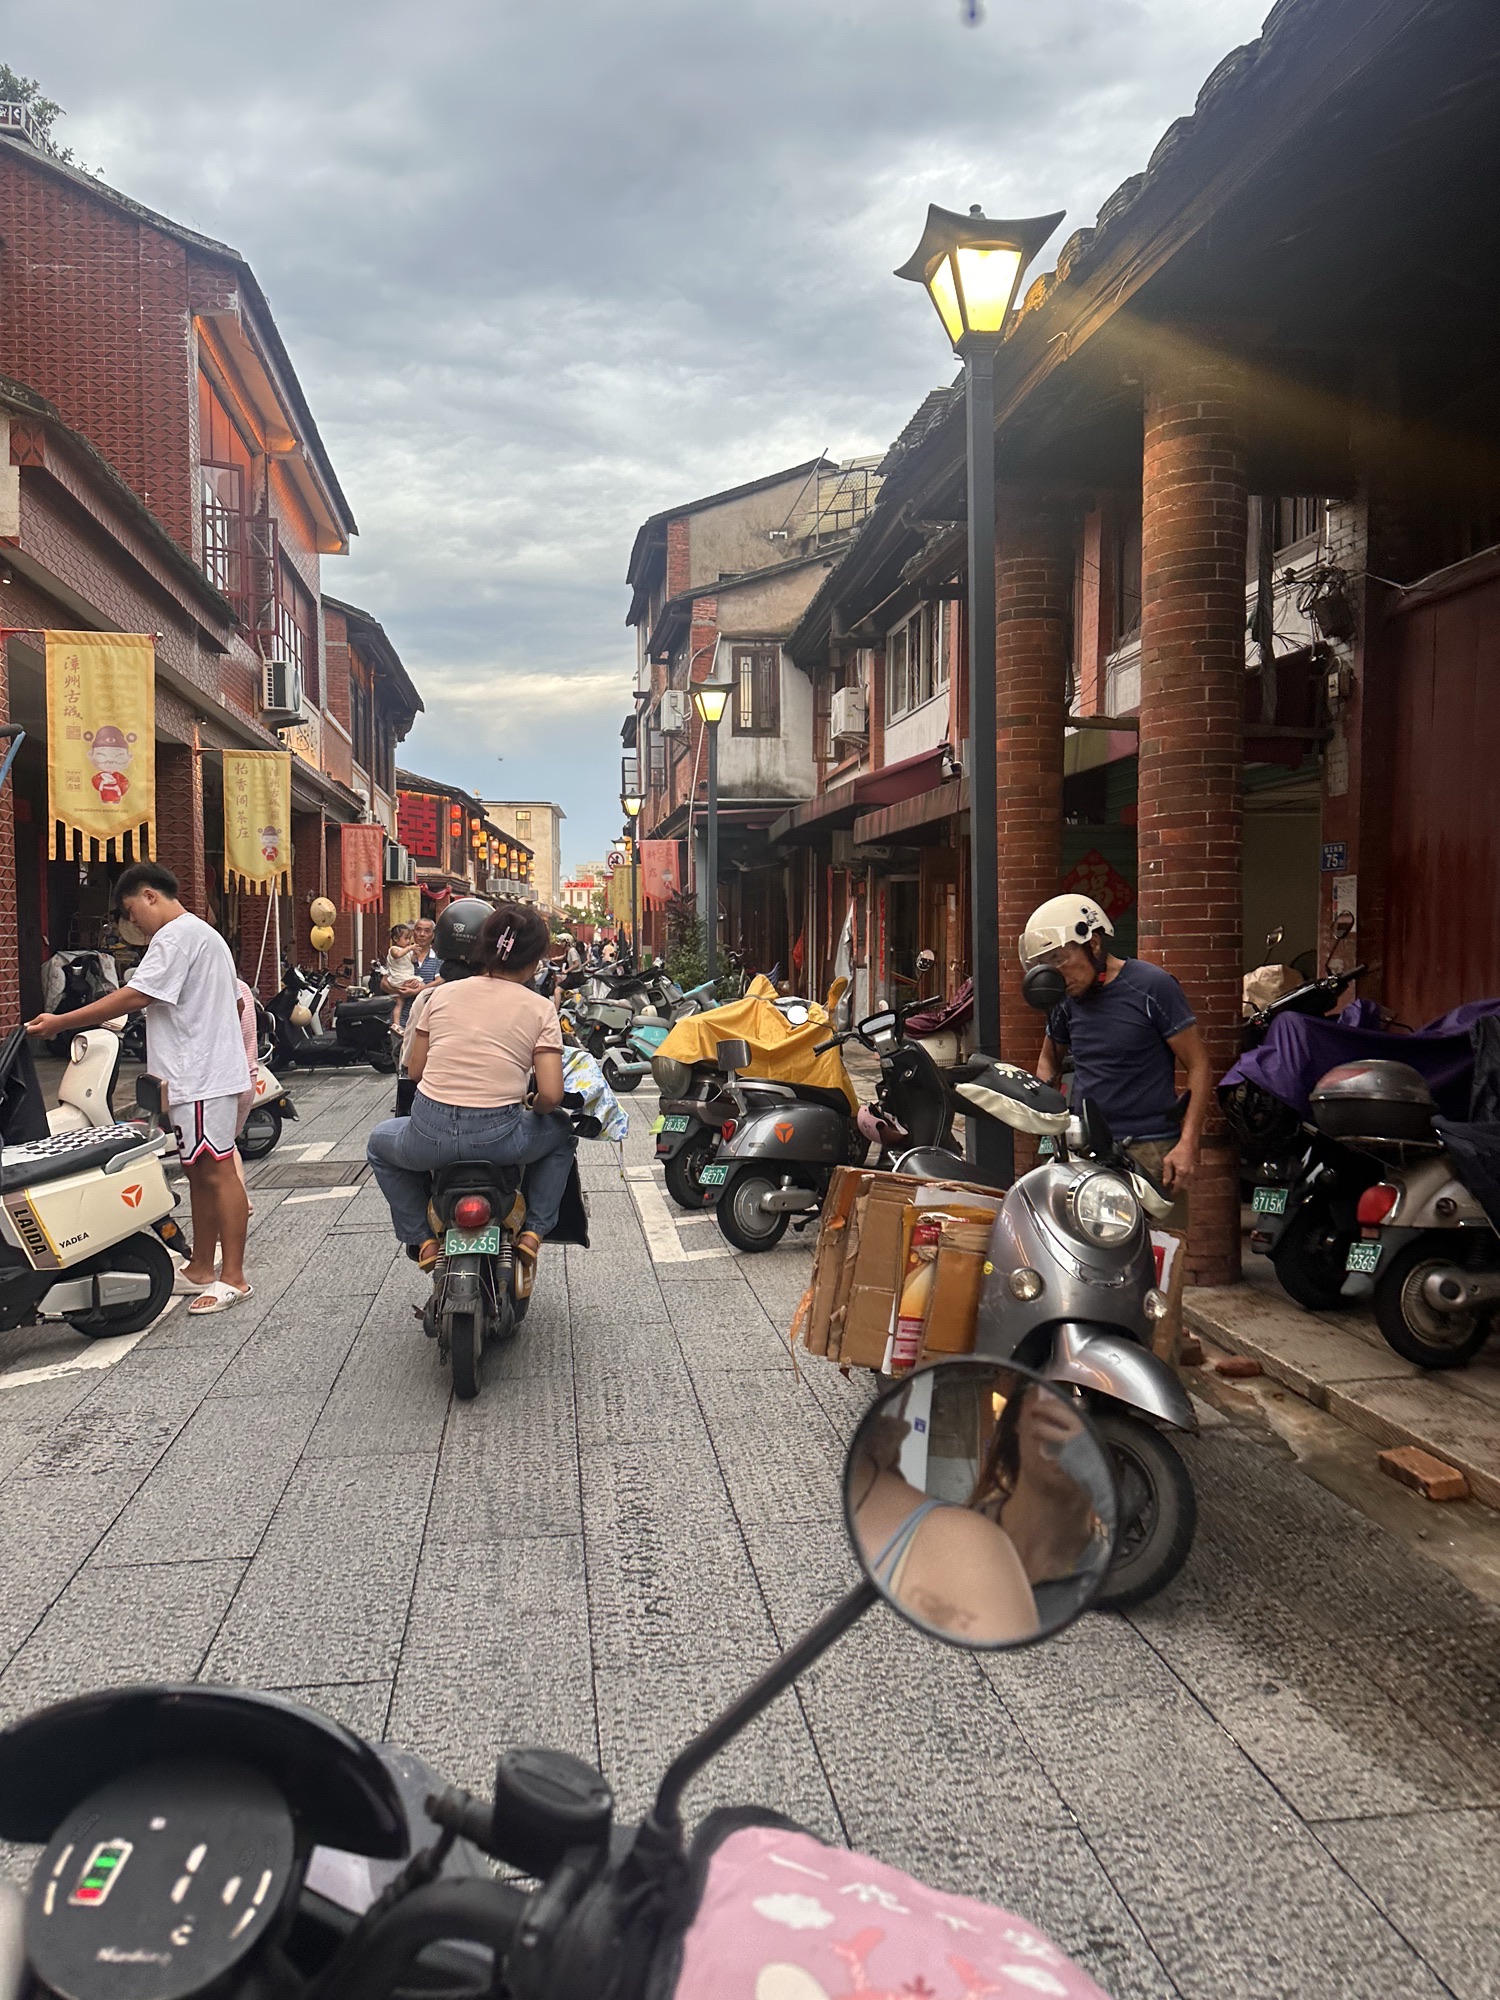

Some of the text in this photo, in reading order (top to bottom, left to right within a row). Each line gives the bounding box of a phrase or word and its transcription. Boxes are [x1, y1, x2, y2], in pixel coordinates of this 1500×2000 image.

[64, 654, 83, 720] 漳州古城
[13, 1208, 48, 1256] LAIDA
[59, 1232, 89, 1249] YADEA
[449, 1236, 497, 1253] S3235
